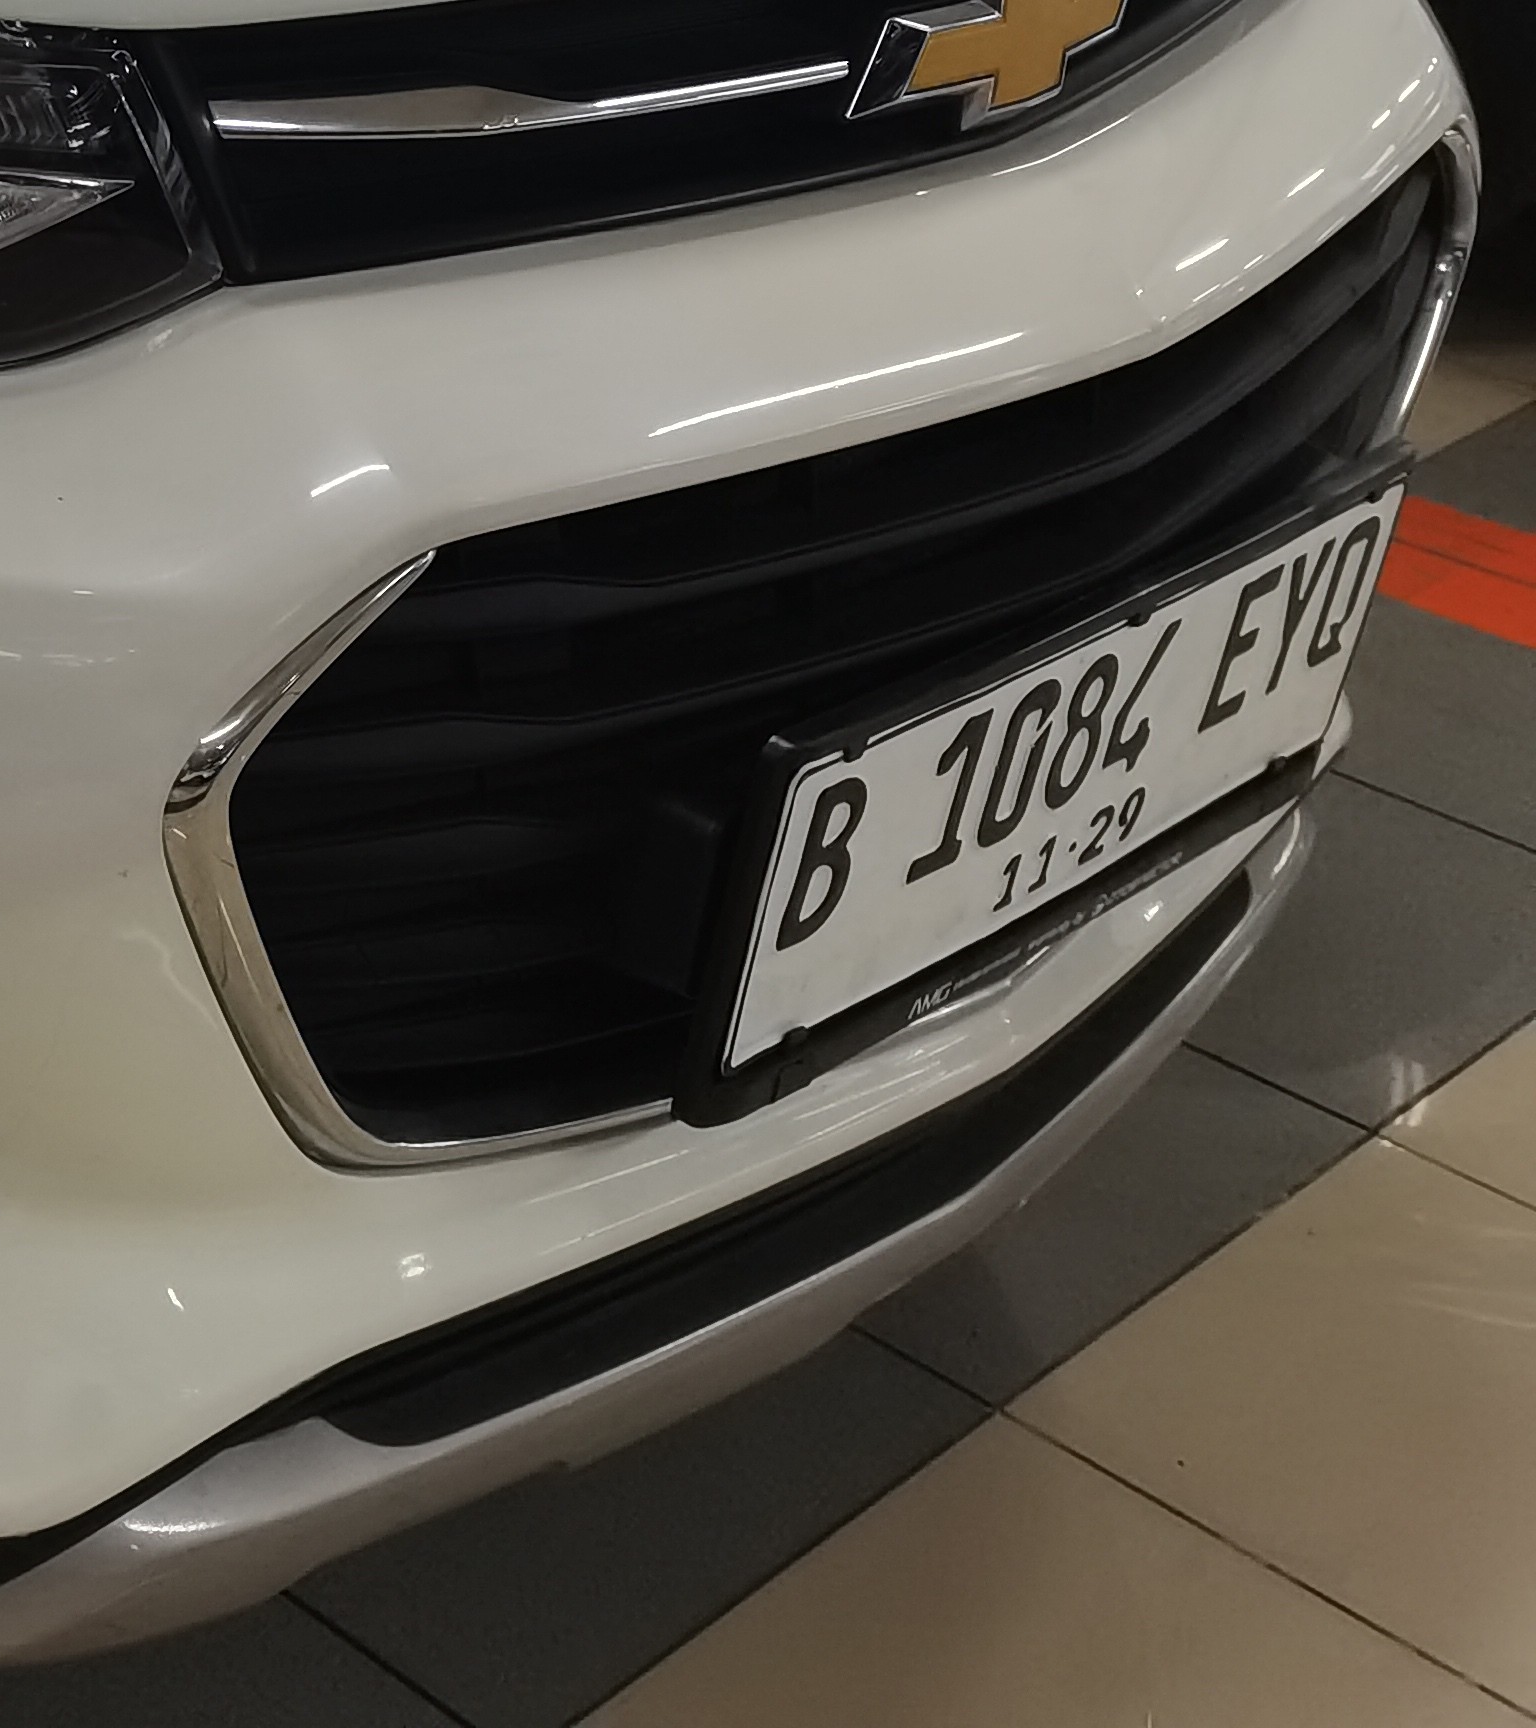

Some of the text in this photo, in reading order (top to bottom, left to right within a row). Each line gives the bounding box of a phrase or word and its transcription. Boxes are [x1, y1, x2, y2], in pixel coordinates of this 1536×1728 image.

[774, 776, 868, 952] B
[904, 618, 1183, 885] 1084
[1197, 515, 1382, 735] EYQ
